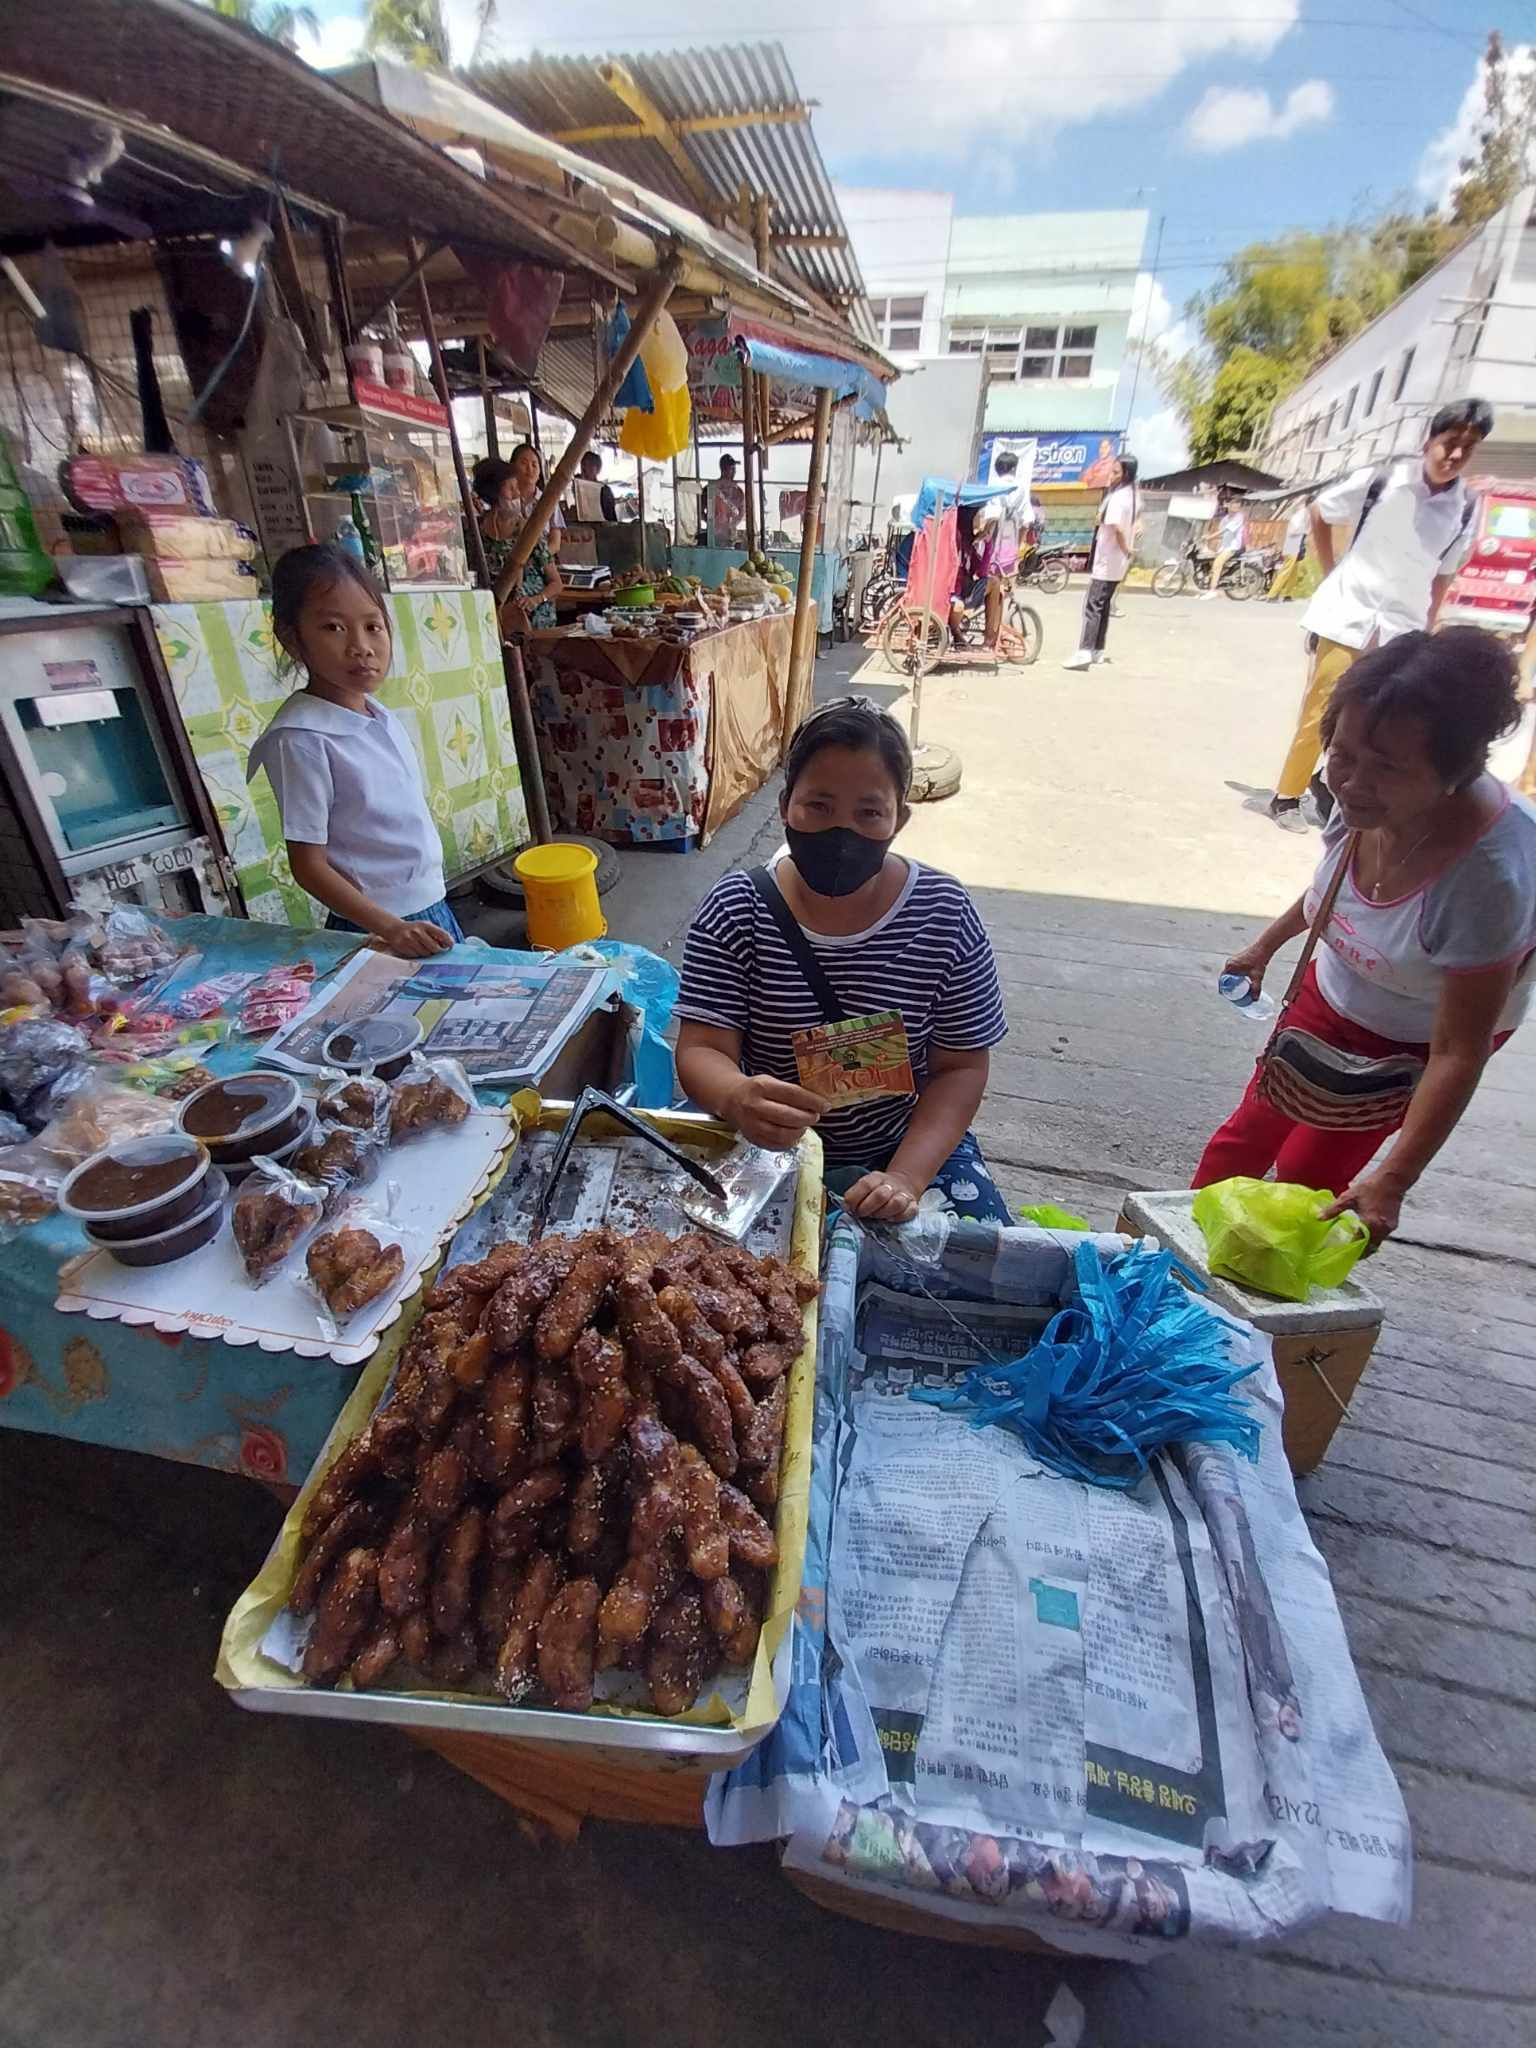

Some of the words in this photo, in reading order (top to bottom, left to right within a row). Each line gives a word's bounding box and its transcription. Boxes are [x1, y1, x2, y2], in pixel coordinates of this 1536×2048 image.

[104, 863, 138, 891] HOT
[152, 846, 193, 874] COLD
[1159, 1784, 1198, 1816] 오세정
